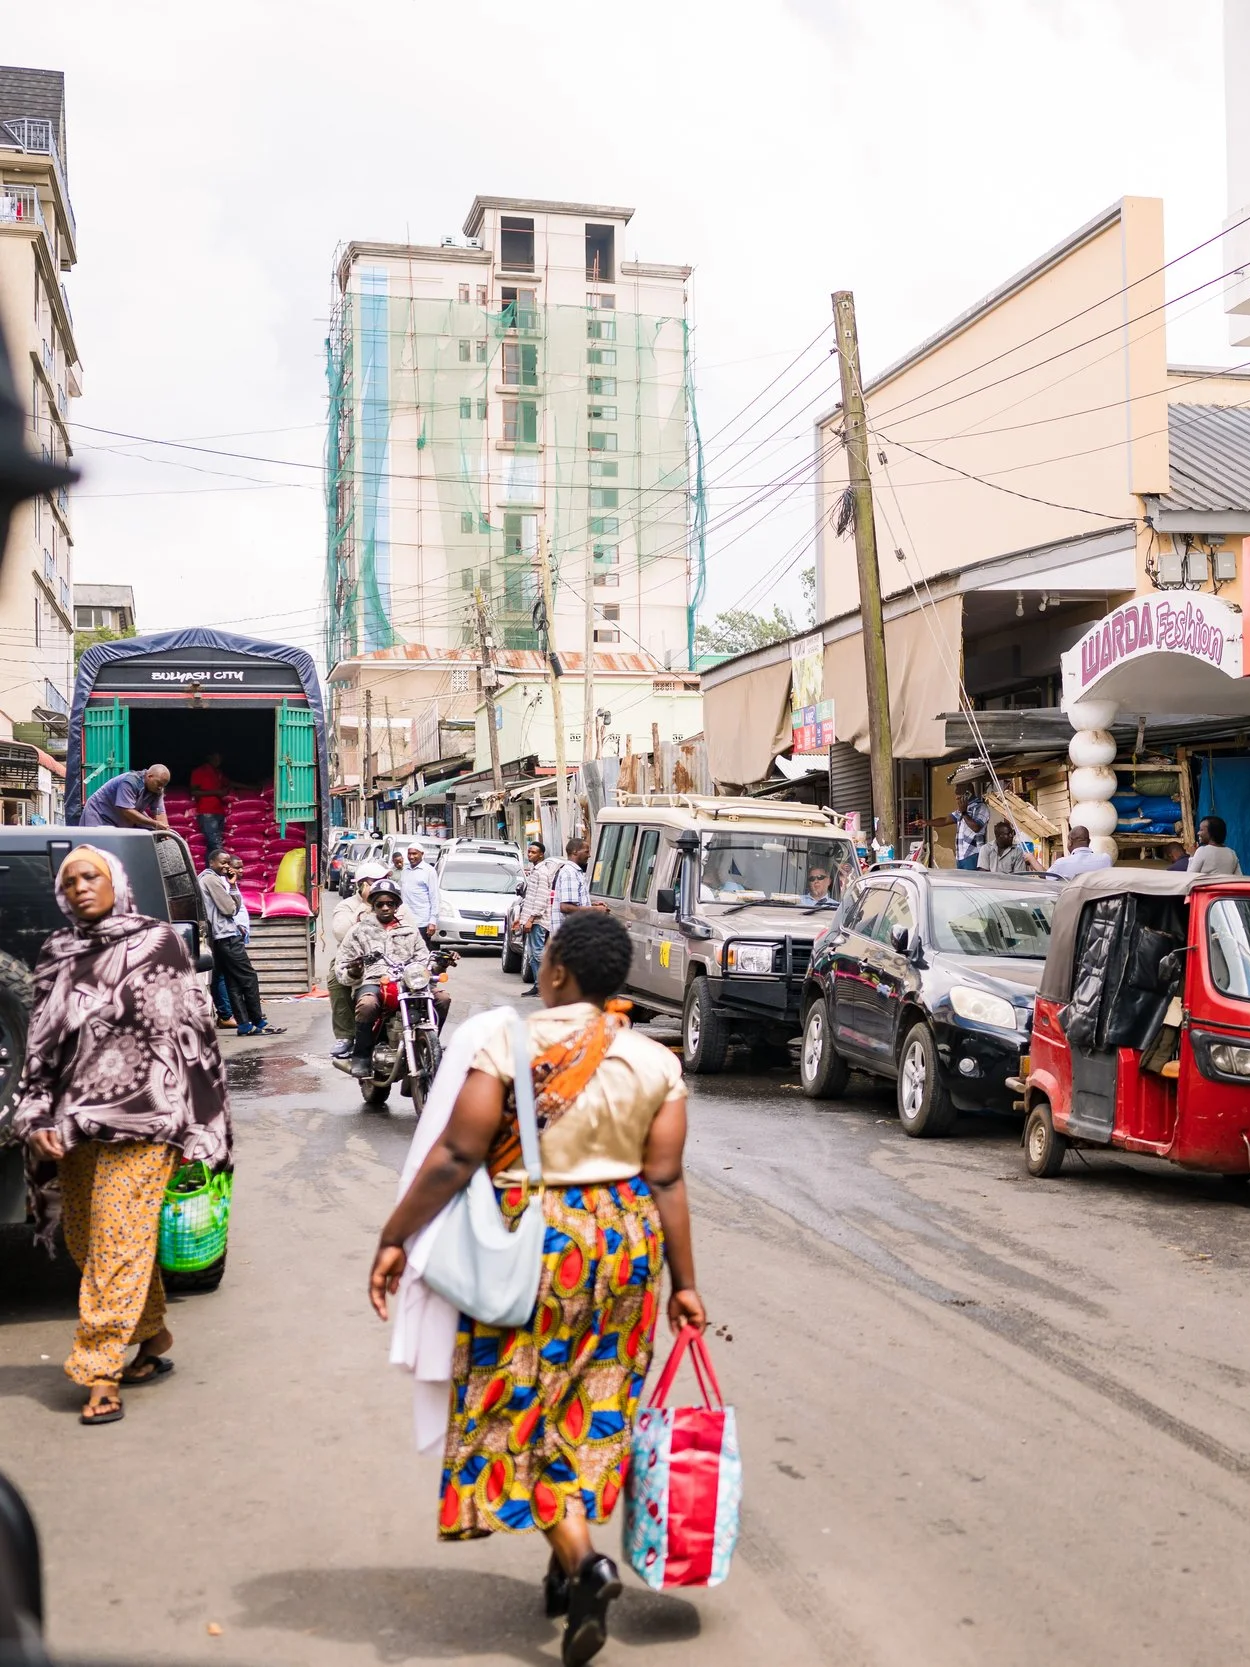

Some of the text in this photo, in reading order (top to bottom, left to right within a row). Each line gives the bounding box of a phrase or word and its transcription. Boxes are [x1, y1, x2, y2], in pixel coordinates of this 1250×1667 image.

[1081, 601, 1224, 687] WARDA Fashion
[151, 671, 244, 683] BULYASH CITY
